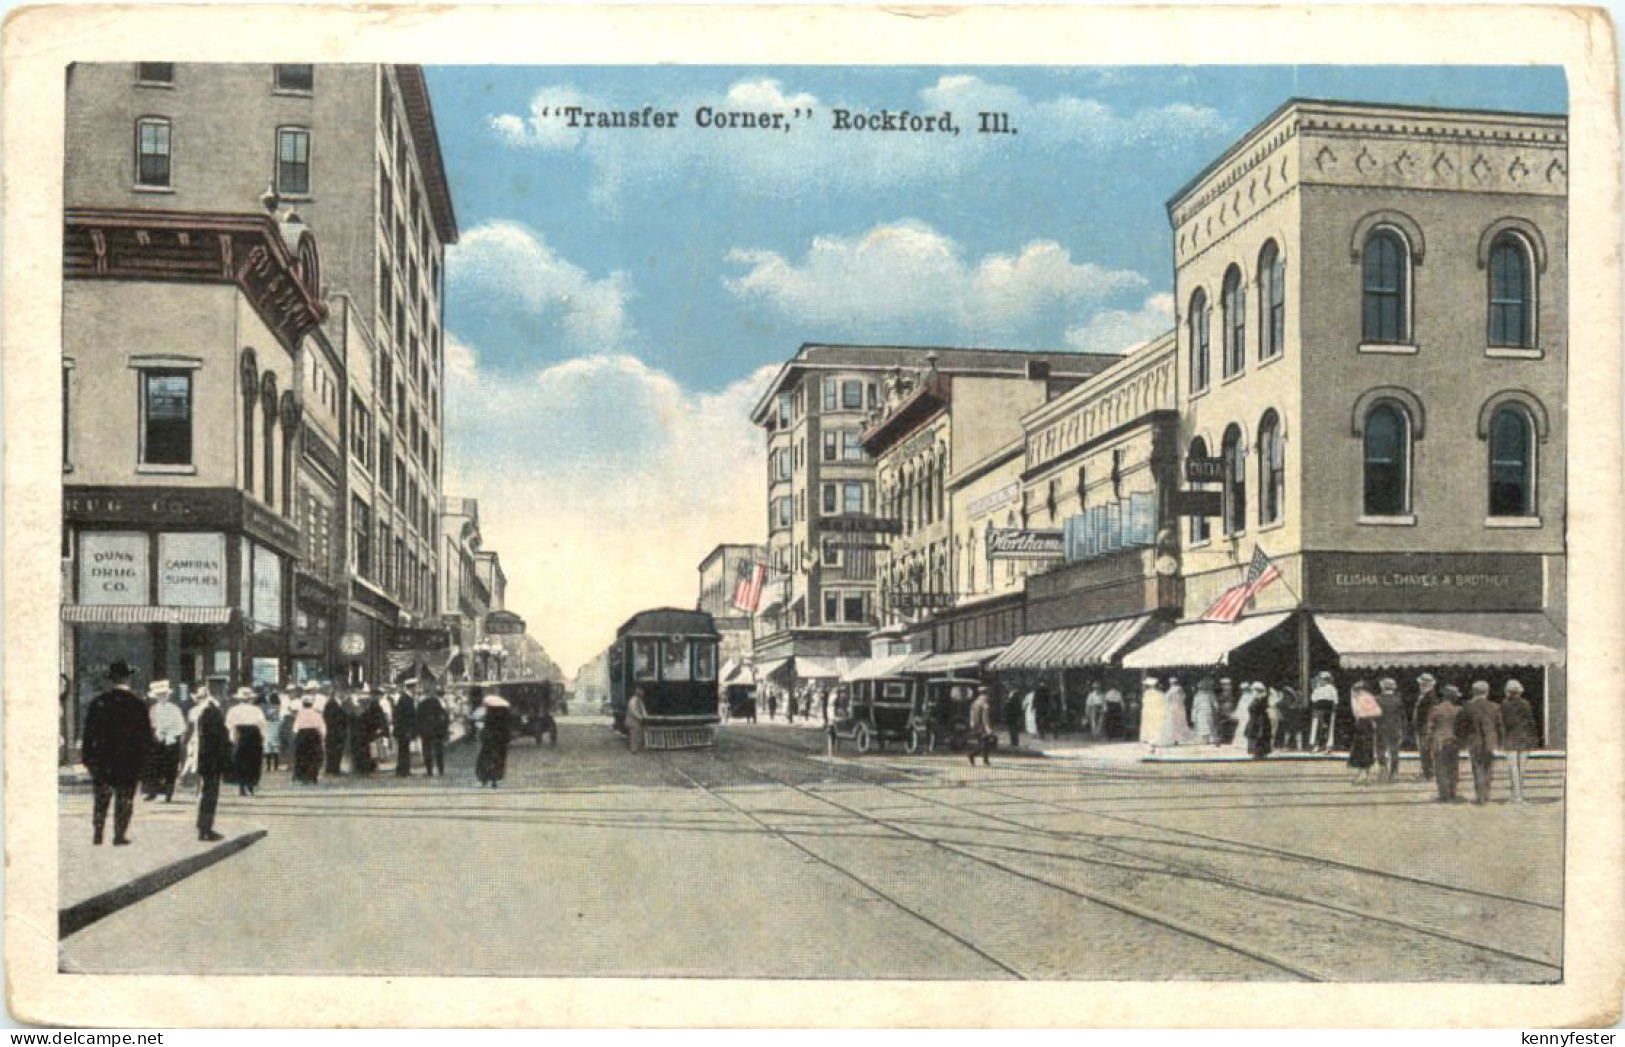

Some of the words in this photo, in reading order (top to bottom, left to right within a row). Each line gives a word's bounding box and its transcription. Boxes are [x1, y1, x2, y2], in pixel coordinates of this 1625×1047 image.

[93, 550, 134, 563] DUNN
[91, 567, 137, 578] DRUG
[103, 581, 129, 592] CO.
